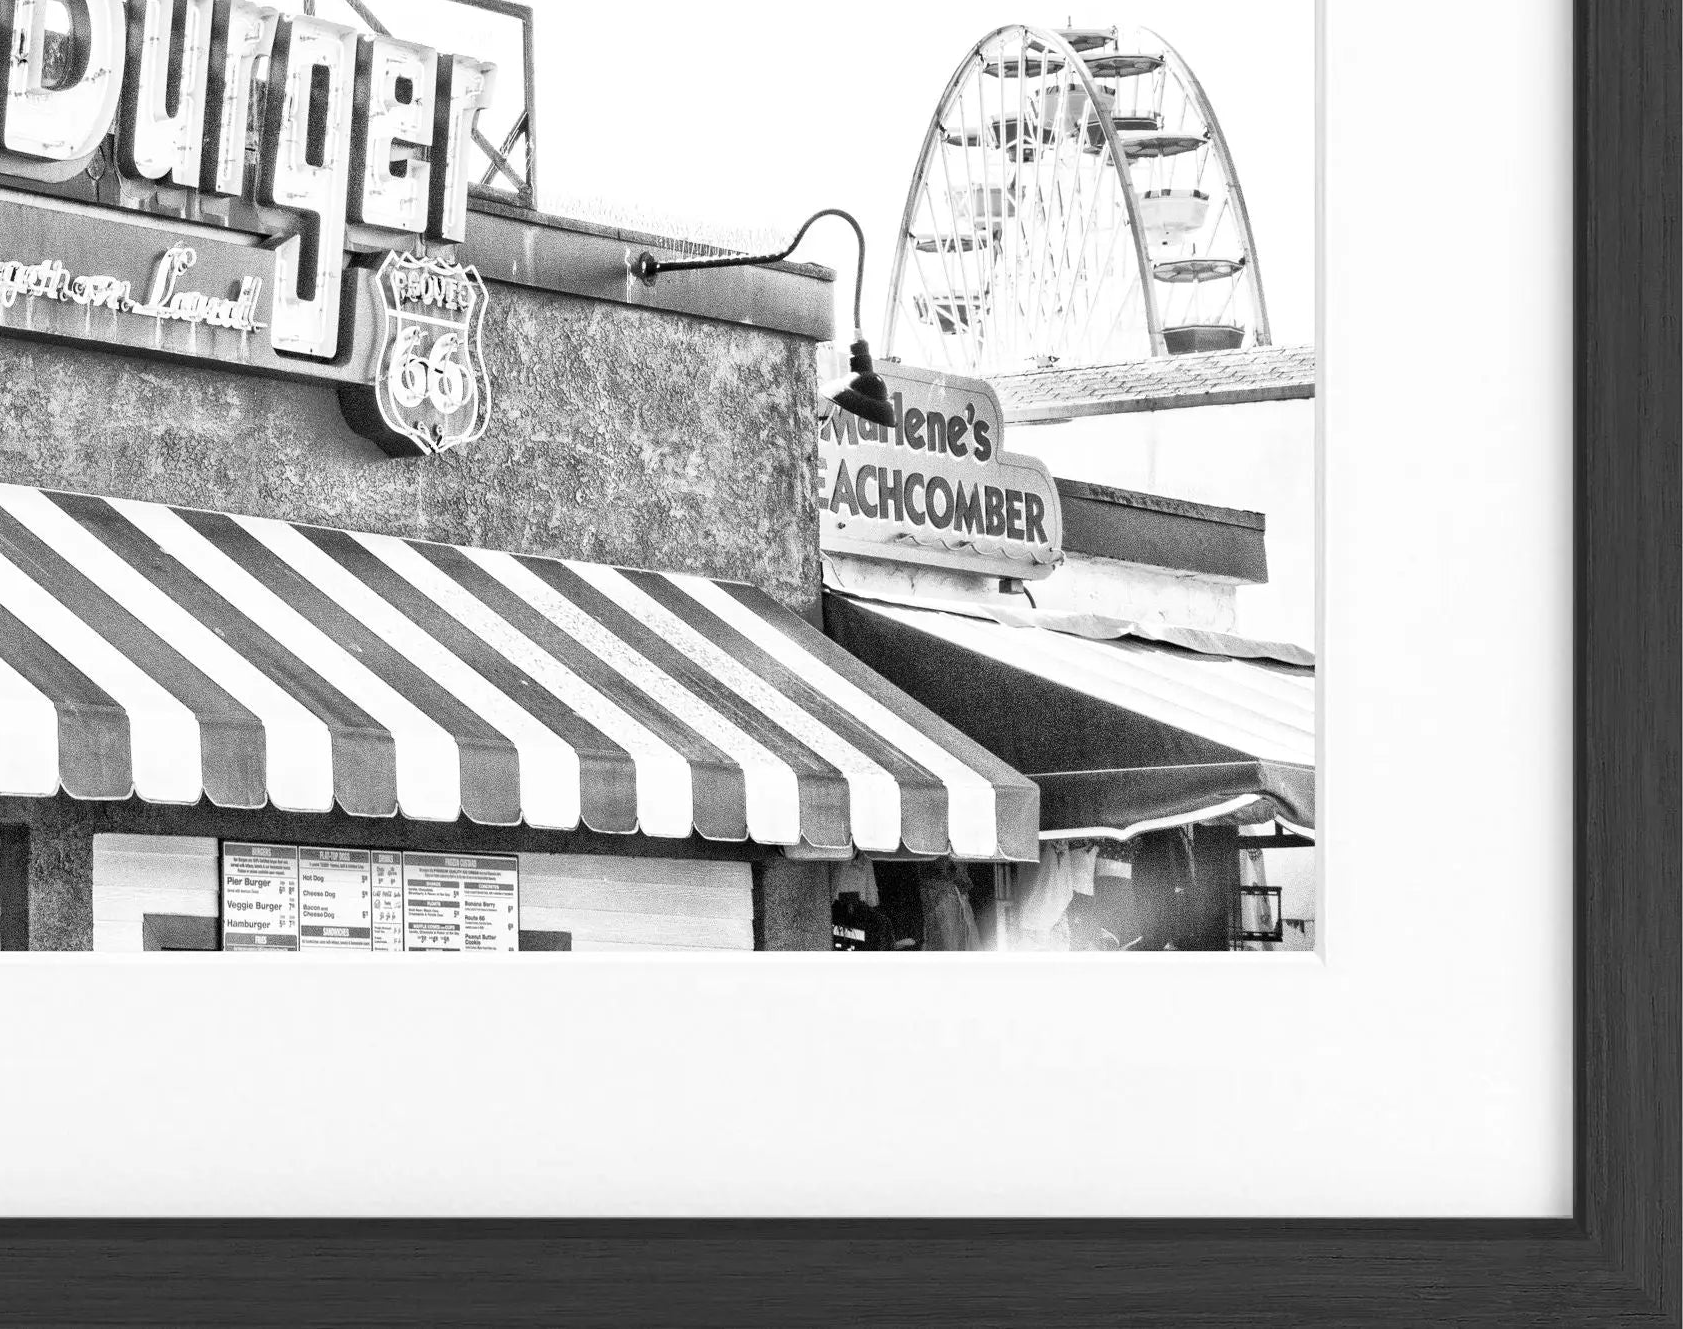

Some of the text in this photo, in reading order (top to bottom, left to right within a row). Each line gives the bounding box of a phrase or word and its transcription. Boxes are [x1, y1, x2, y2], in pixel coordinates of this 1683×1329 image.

[390, 325, 474, 415] 66
[227, 877, 242, 886] Pier
[244, 878, 271, 889] Burger
[313, 875, 324, 883] Dog
[324, 891, 336, 899] Dog
[227, 900, 254, 911] Veggie
[255, 901, 282, 912] Burger
[227, 919, 271, 930] Hamburger
